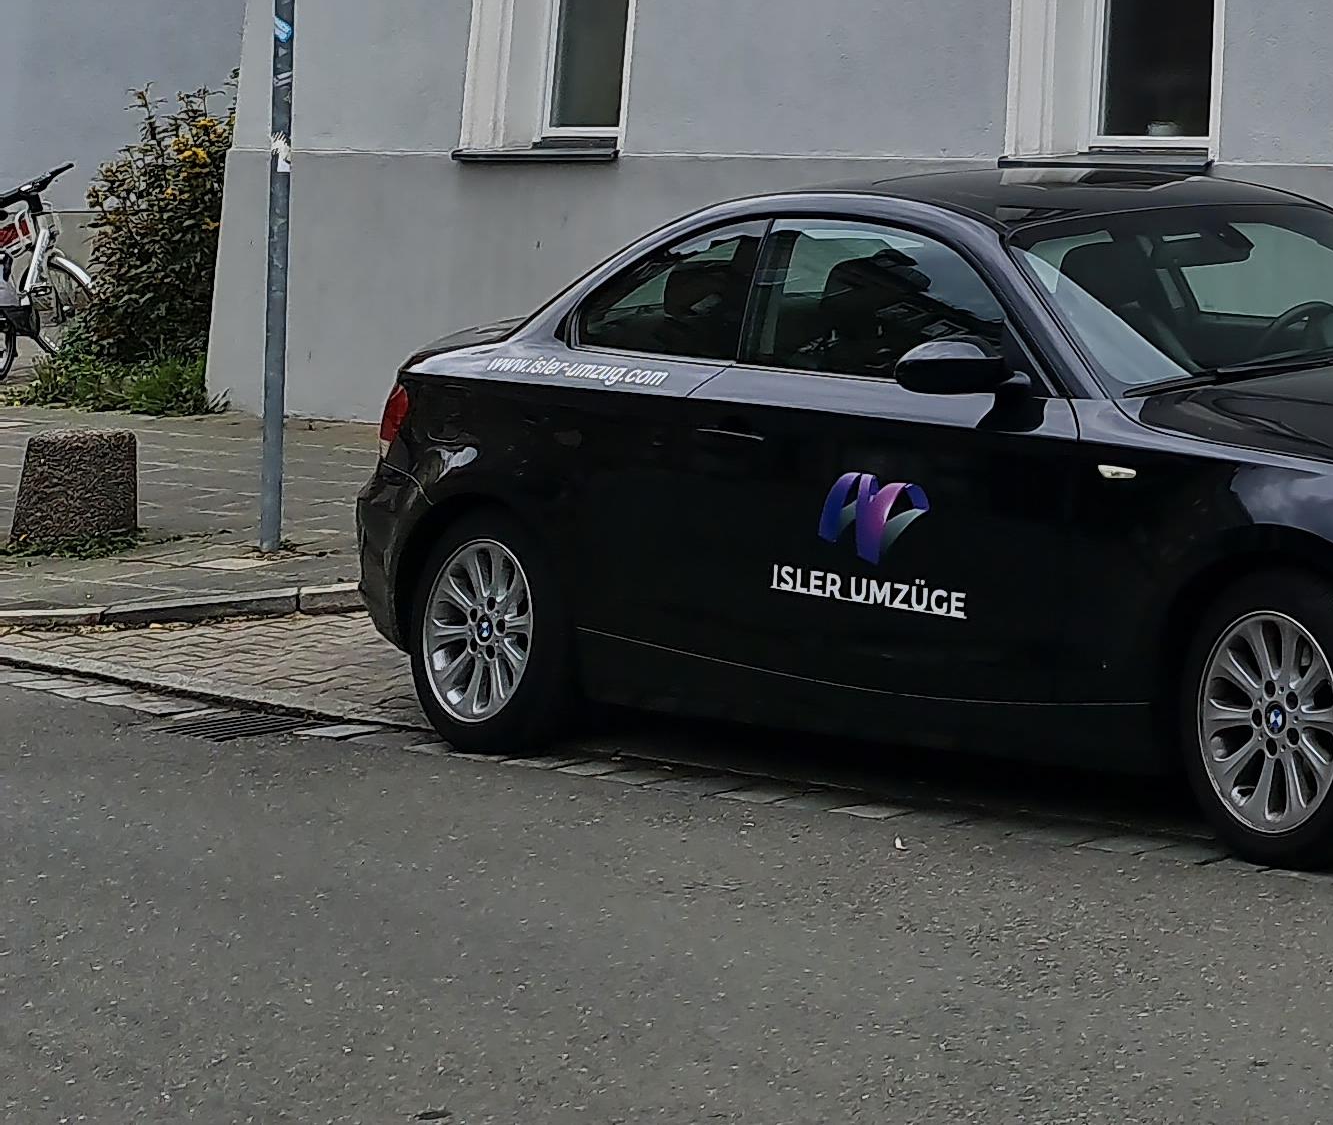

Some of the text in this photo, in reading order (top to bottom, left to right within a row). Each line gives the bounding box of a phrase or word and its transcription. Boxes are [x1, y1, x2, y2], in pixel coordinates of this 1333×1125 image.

[486, 355, 670, 387] www.isler-umzug.com
[771, 563, 967, 619] ISLER UMZÜGE
